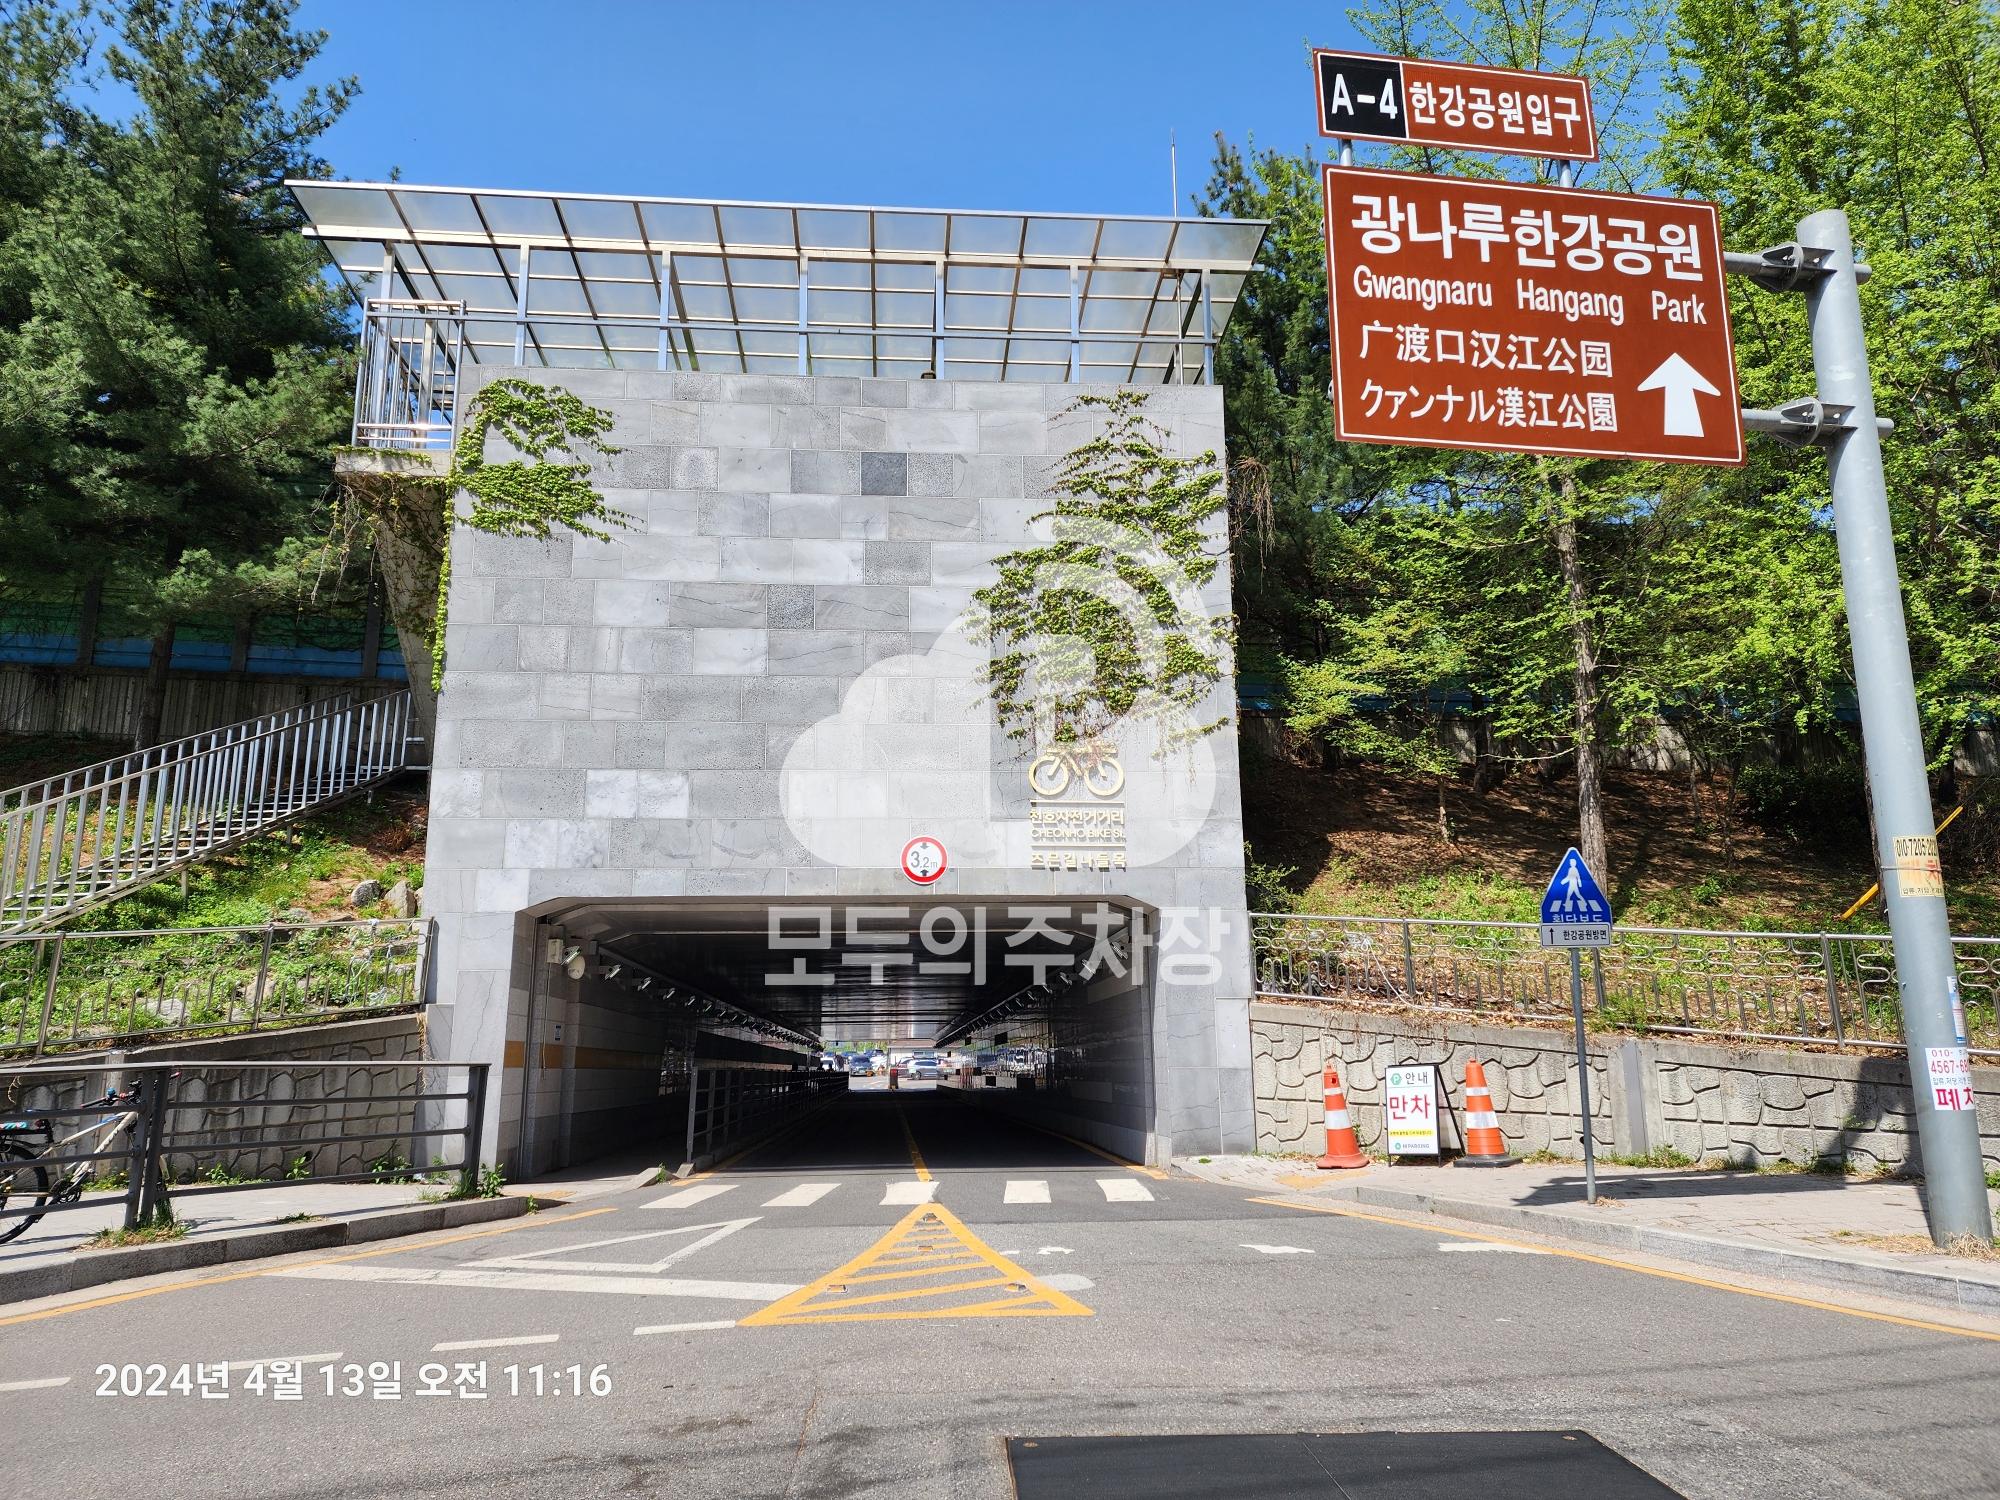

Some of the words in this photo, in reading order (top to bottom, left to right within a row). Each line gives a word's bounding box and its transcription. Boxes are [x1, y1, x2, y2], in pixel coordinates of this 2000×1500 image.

[1331, 73, 1398, 120] A-4
[1409, 81, 1581, 138] 한강공원입구
[1351, 195, 1703, 282] 광나루한강공원
[1353, 265, 1492, 311] Gwangnaru
[1517, 279, 1623, 326] Hangang
[1652, 291, 1707, 325] Park
[1359, 319, 1613, 378] 广渡口汉江公园
[1031, 828, 1087, 839] CHEONHO
[1088, 828, 1112, 839] BIKE
[911, 850, 938, 868] 3.2m
[1563, 929, 1607, 941] 한강공원방면
[1405, 1071, 1428, 1085] 안내
[1389, 1094, 1430, 1120] 만차
